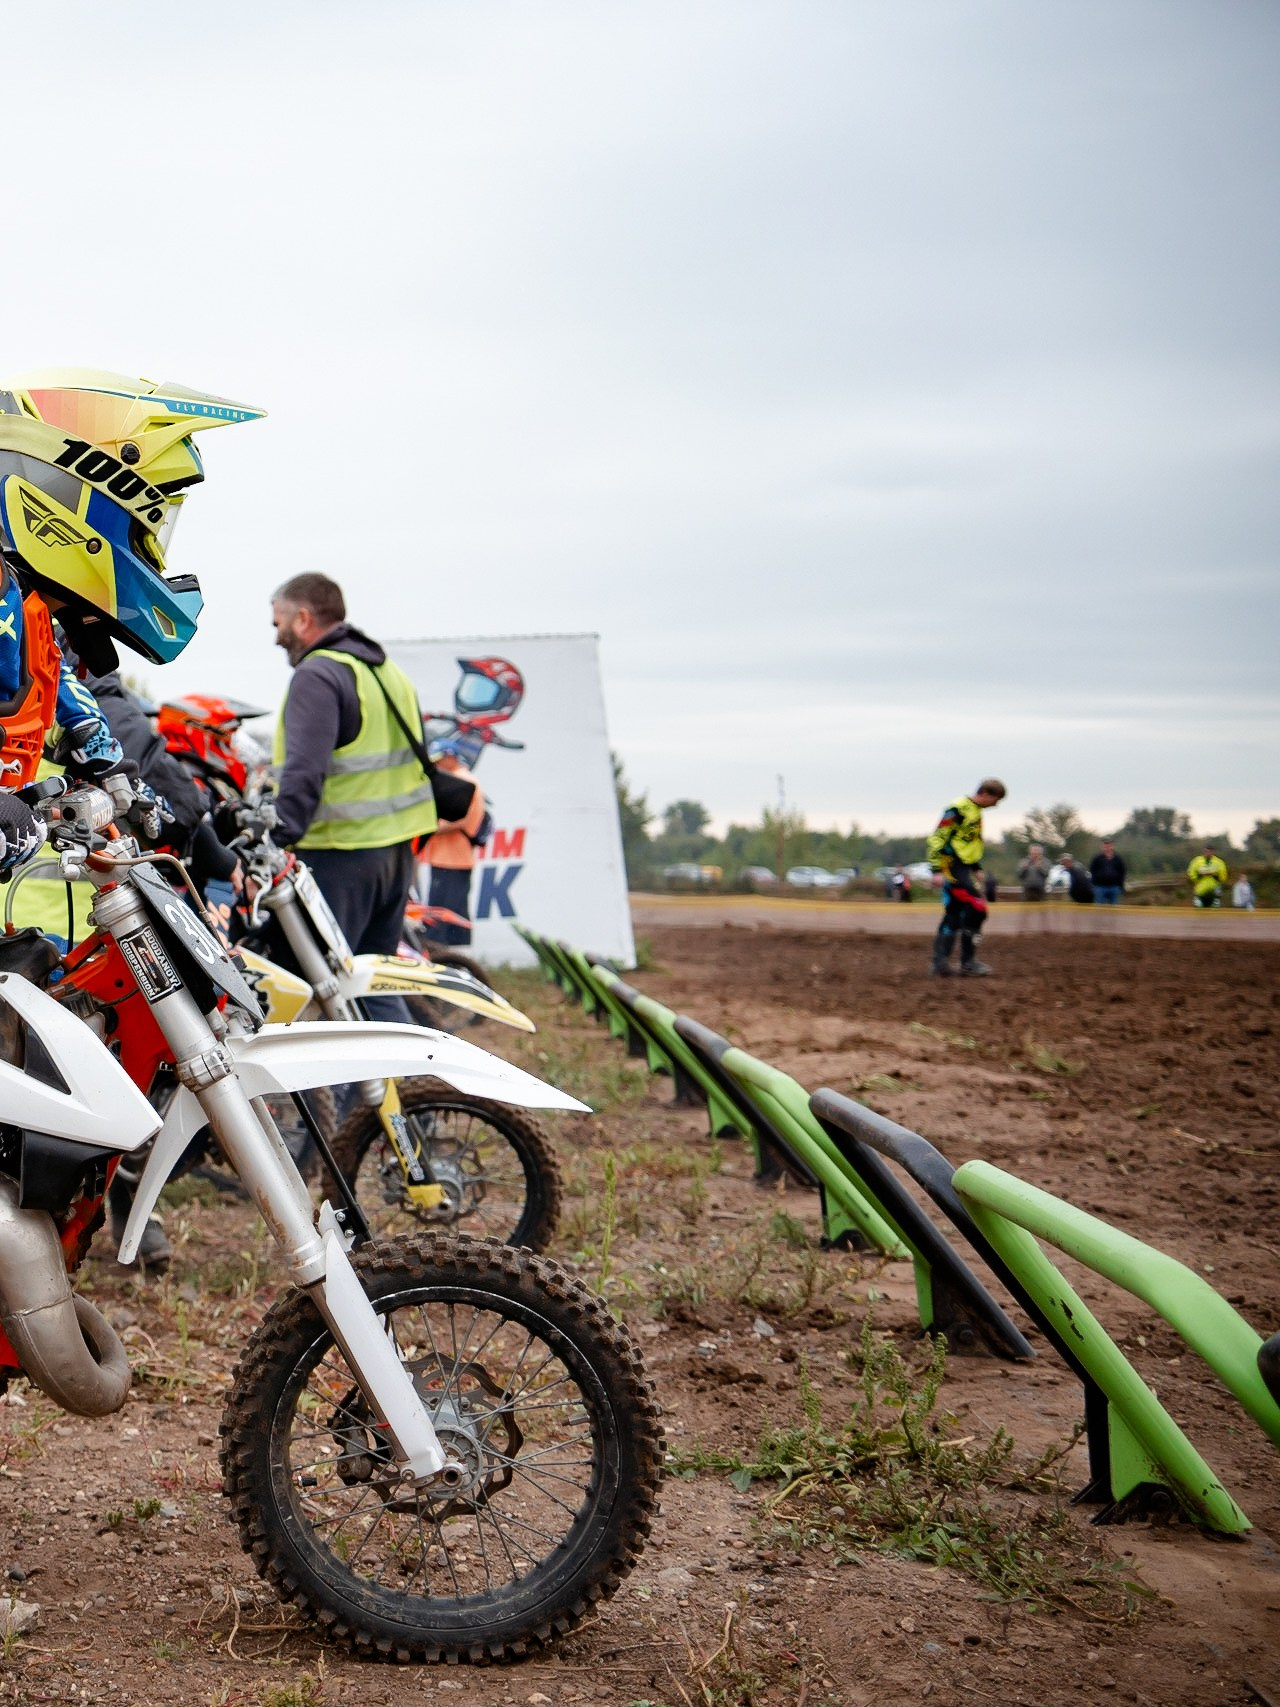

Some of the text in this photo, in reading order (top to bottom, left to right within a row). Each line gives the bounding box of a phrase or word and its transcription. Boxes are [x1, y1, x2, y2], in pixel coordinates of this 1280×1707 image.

[175, 402, 246, 420] FLY RACING
[53, 438, 166, 524] 100%
[122, 942, 157, 998] SUSPENSION
